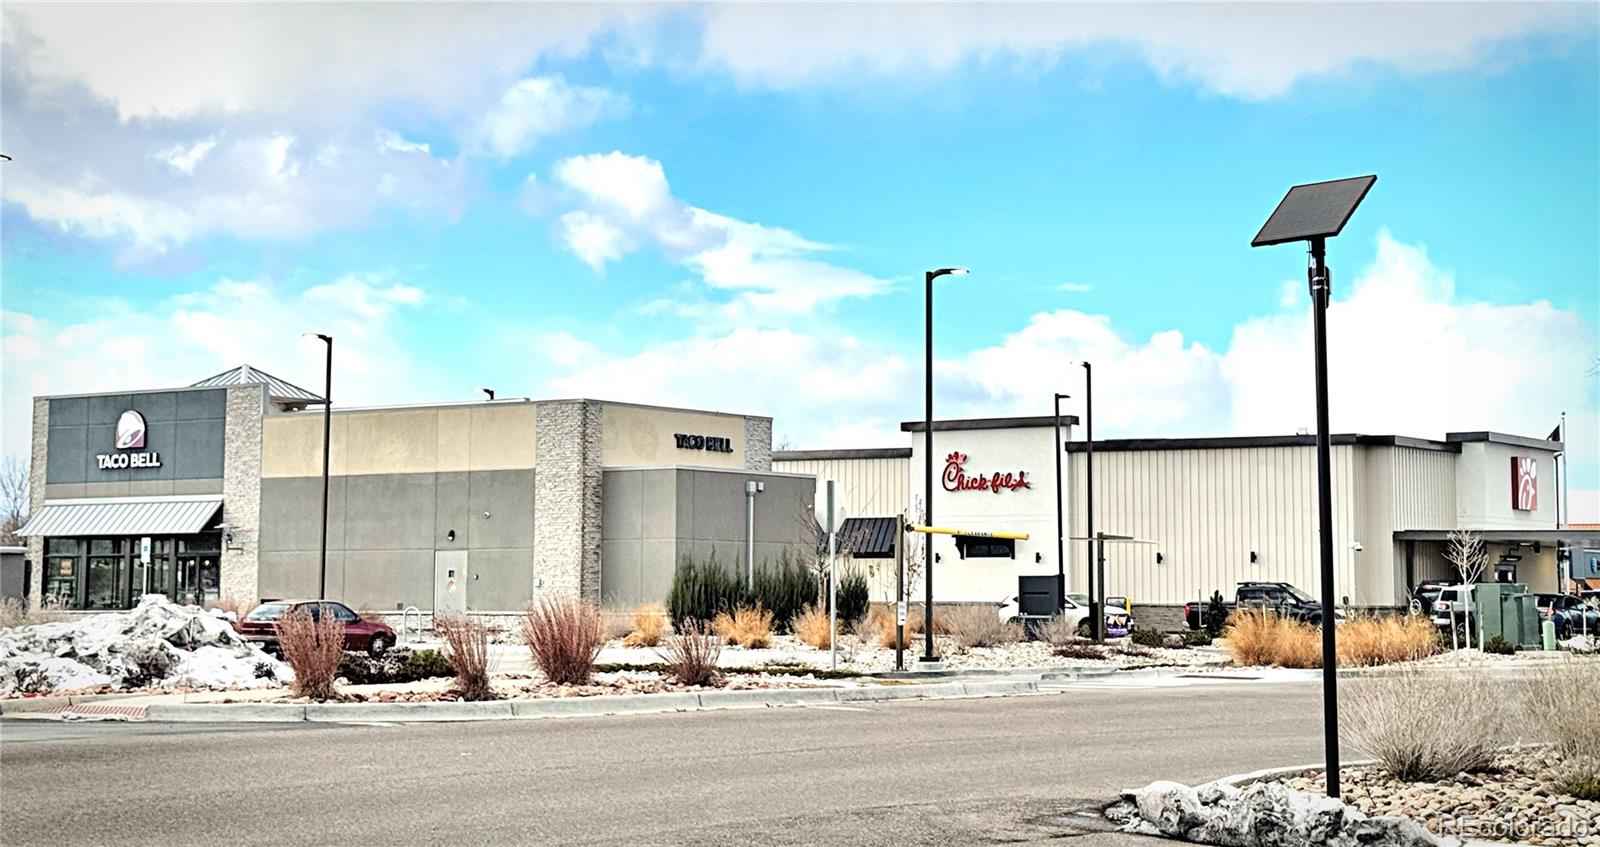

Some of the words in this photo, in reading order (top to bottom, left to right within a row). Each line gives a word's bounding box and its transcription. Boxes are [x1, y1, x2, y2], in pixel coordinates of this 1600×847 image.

[673, 433, 705, 450] TACO
[705, 436, 734, 453] BELL
[96, 453, 129, 469] TACO
[130, 452, 161, 468] BELL
[942, 458, 1031, 494] Chick-fil-A
